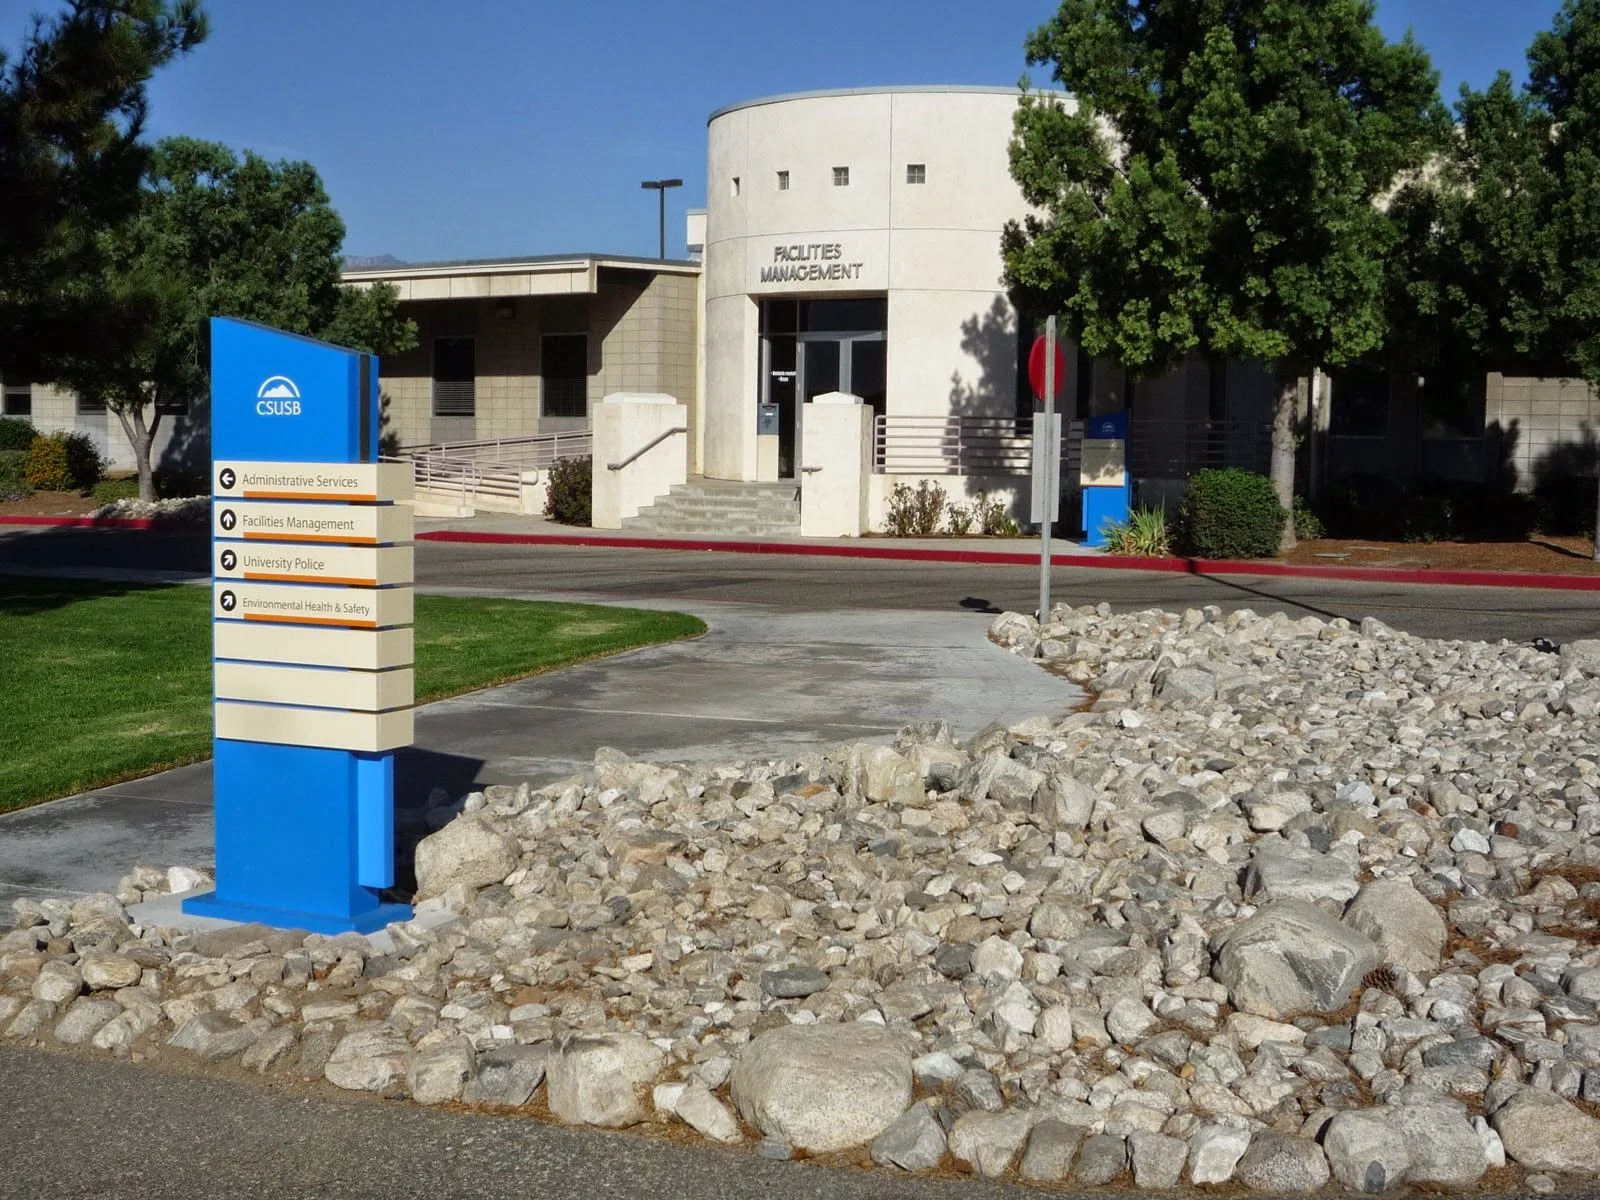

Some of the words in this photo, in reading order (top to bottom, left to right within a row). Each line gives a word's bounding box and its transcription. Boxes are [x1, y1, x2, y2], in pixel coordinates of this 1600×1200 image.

[774, 244, 842, 262] FACILITIES
[761, 263, 863, 283] MANAGEMENT
[256, 400, 301, 416] CSUSB
[242, 474, 314, 488] Administrative
[316, 476, 358, 488] Services
[242, 515, 284, 528] Facilities
[287, 516, 354, 532] Management
[243, 556, 292, 571] University
[295, 557, 325, 570] Police
[242, 598, 303, 611] Environmental
[304, 600, 333, 613] Health
[335, 603, 341, 613] &
[343, 603, 370, 616] Safety
